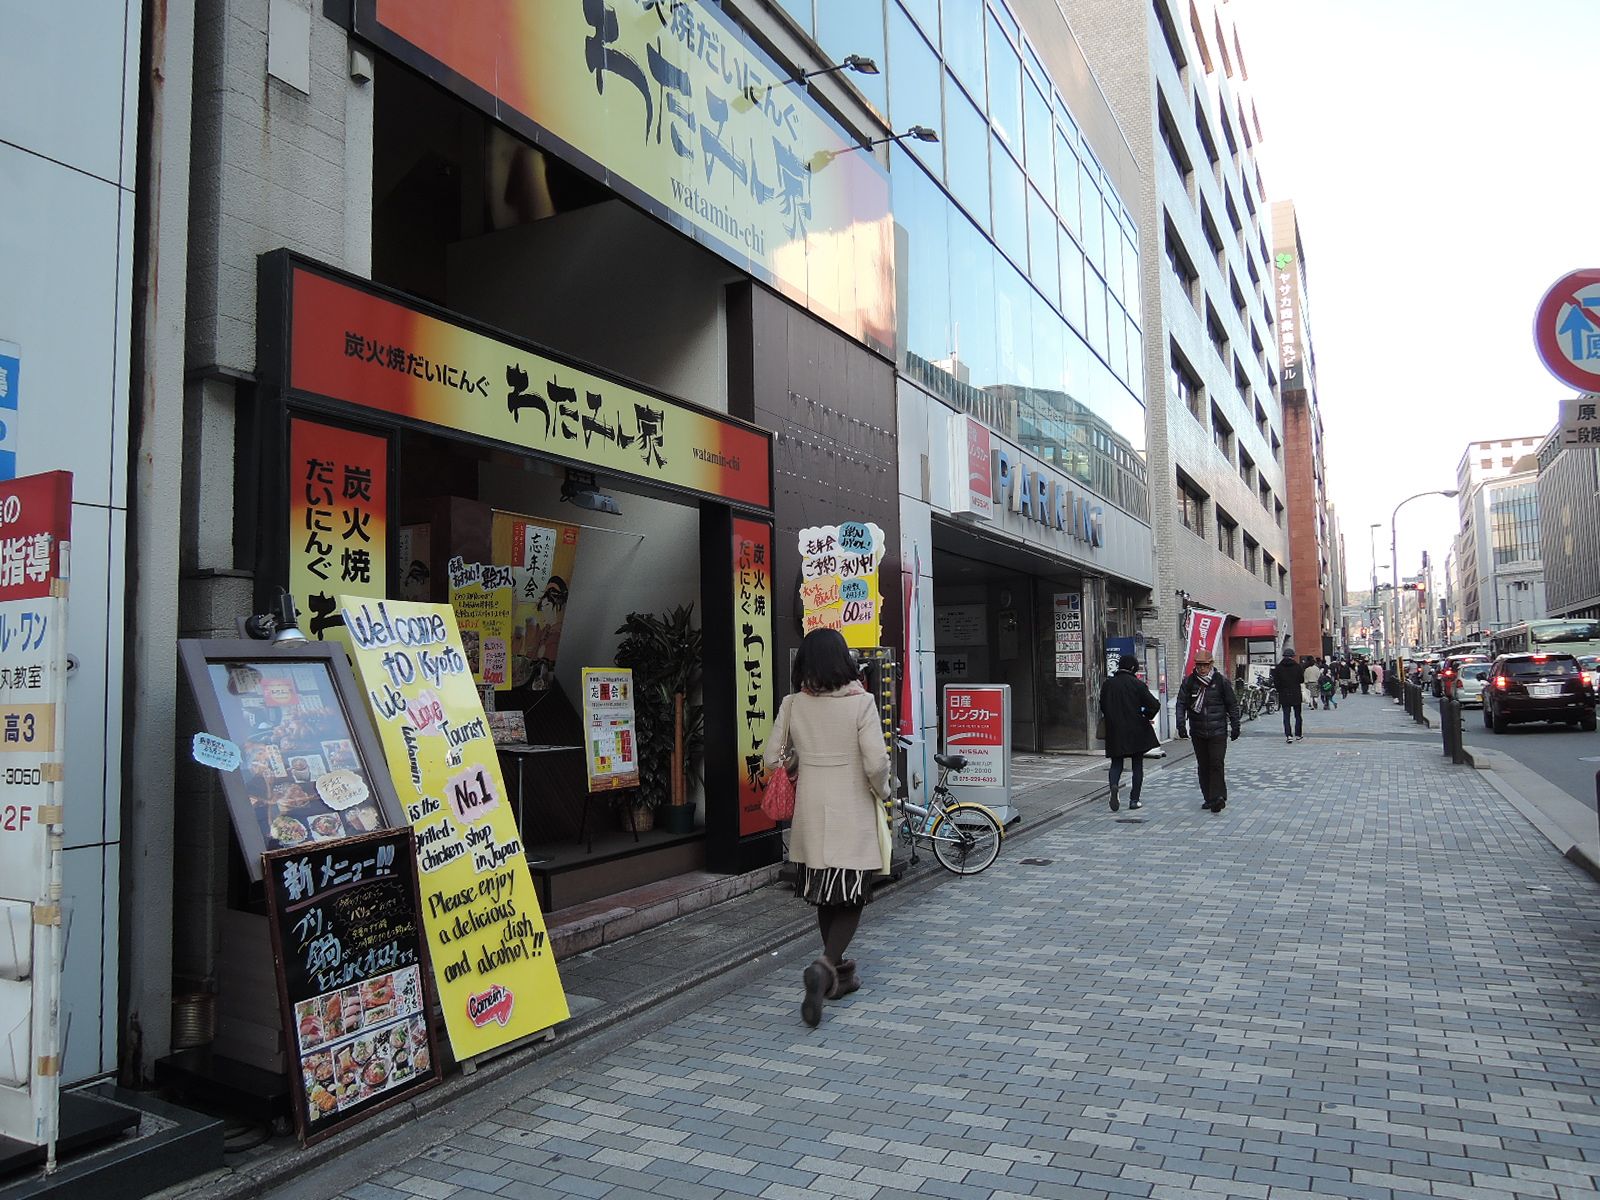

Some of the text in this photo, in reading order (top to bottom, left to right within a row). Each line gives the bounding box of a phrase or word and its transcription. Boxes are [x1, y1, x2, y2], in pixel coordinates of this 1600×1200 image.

[670, 177, 765, 256] watamin-chi
[343, 331, 490, 398] 炭火焼だいにんぐ
[505, 362, 668, 470] わたみん家
[692, 446, 741, 471] watamin-chi
[991, 447, 1104, 549] PARKING
[304, 458, 335, 581] だいにんぐ
[341, 465, 372, 584] 炭火焼
[0, 532, 52, 587] 指導
[806, 535, 837, 555] 忘年会
[523, 532, 543, 599] 忘年会
[753, 543, 766, 616] 炭火焼
[806, 555, 837, 577] ご予約
[342, 601, 447, 646] Welcome
[1055, 621, 1081, 630] 300円
[416, 646, 465, 687] Kyoto
[371, 684, 407, 721] We
[407, 700, 444, 731] Love
[950, 695, 971, 707] 日産
[950, 709, 999, 721] レンタカー
[4, 713, 35, 743] 高3
[437, 717, 487, 748] Tourist
[409, 770, 494, 822] is the No.1
[421, 840, 464, 872] chicken
[465, 825, 492, 849] shop
[475, 841, 520, 870] in Japan
[428, 889, 476, 919] Please
[478, 869, 515, 902] enjoy
[439, 927, 452, 945] a
[452, 898, 517, 940] delicious
[503, 912, 535, 943] dish
[444, 950, 471, 984] and
